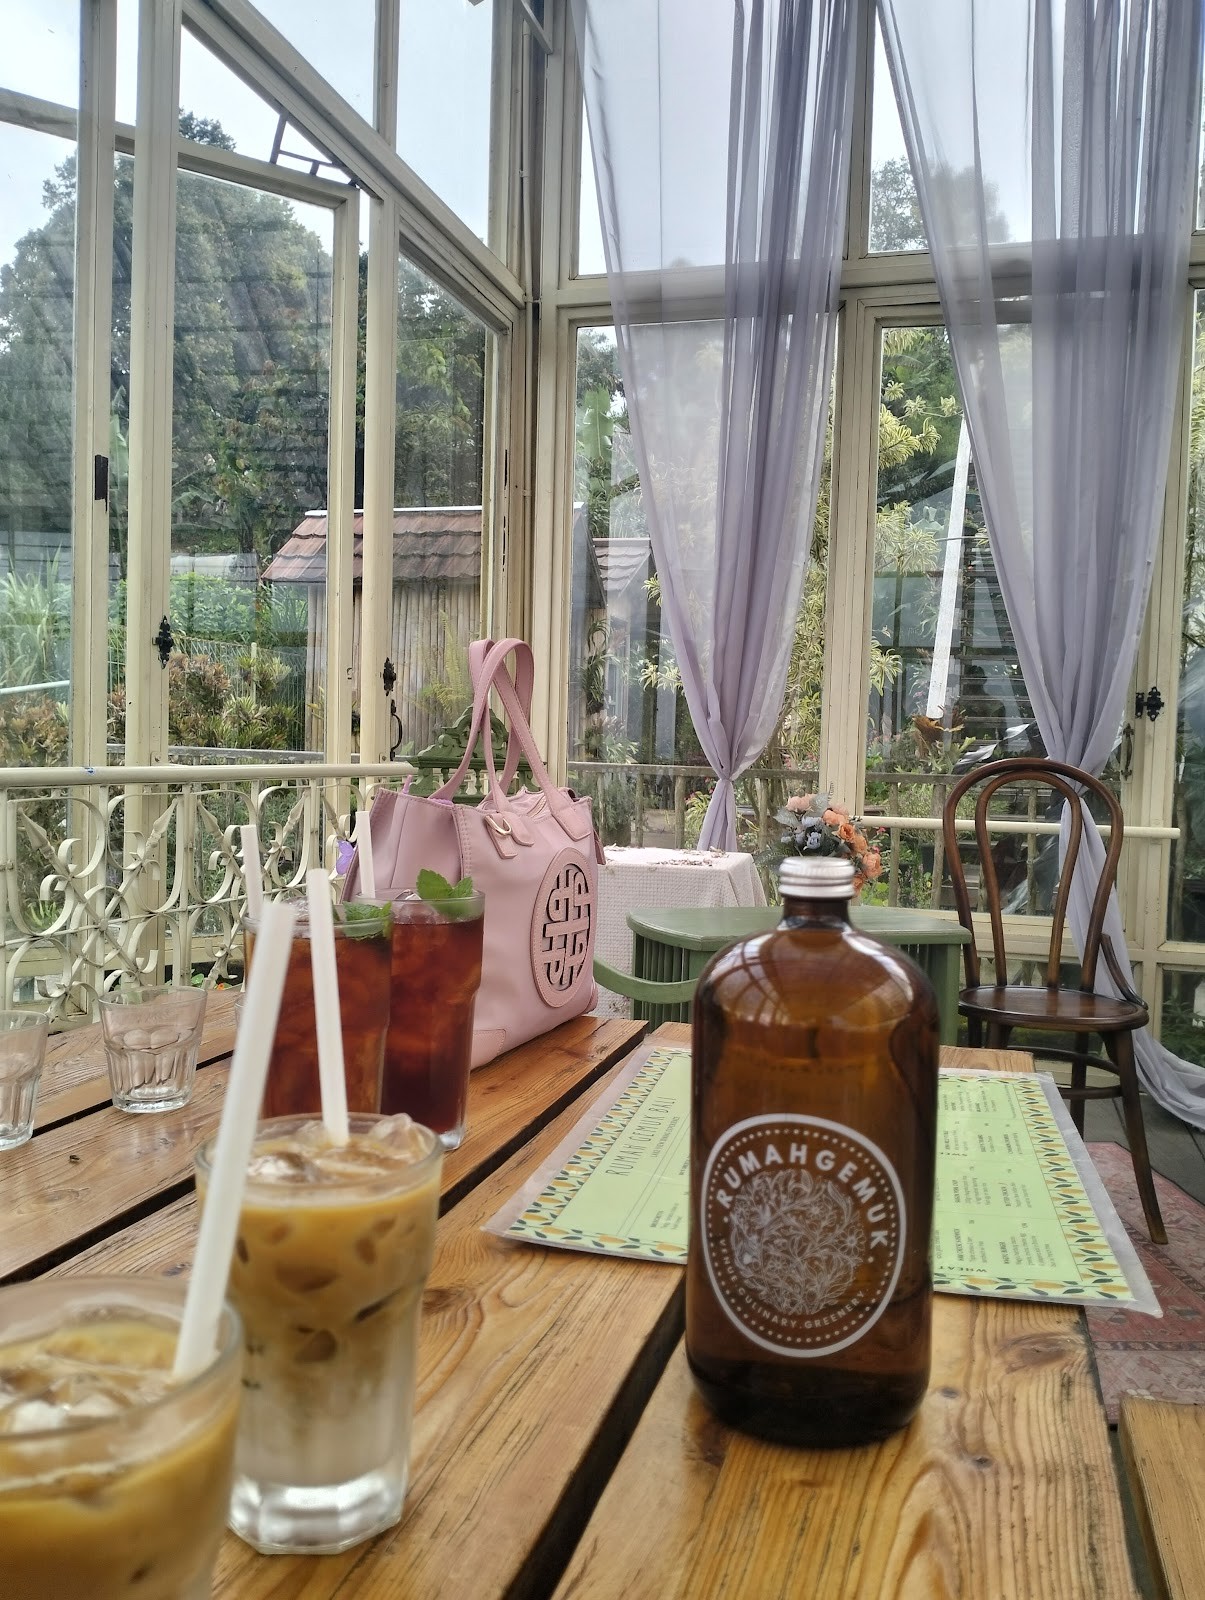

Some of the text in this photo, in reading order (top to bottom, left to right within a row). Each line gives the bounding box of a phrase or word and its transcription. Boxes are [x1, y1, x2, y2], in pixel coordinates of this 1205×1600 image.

[605, 1096, 677, 1177] RUMAH GEMUK BALI
[716, 1142, 889, 1250] RUMAHGEMUK
